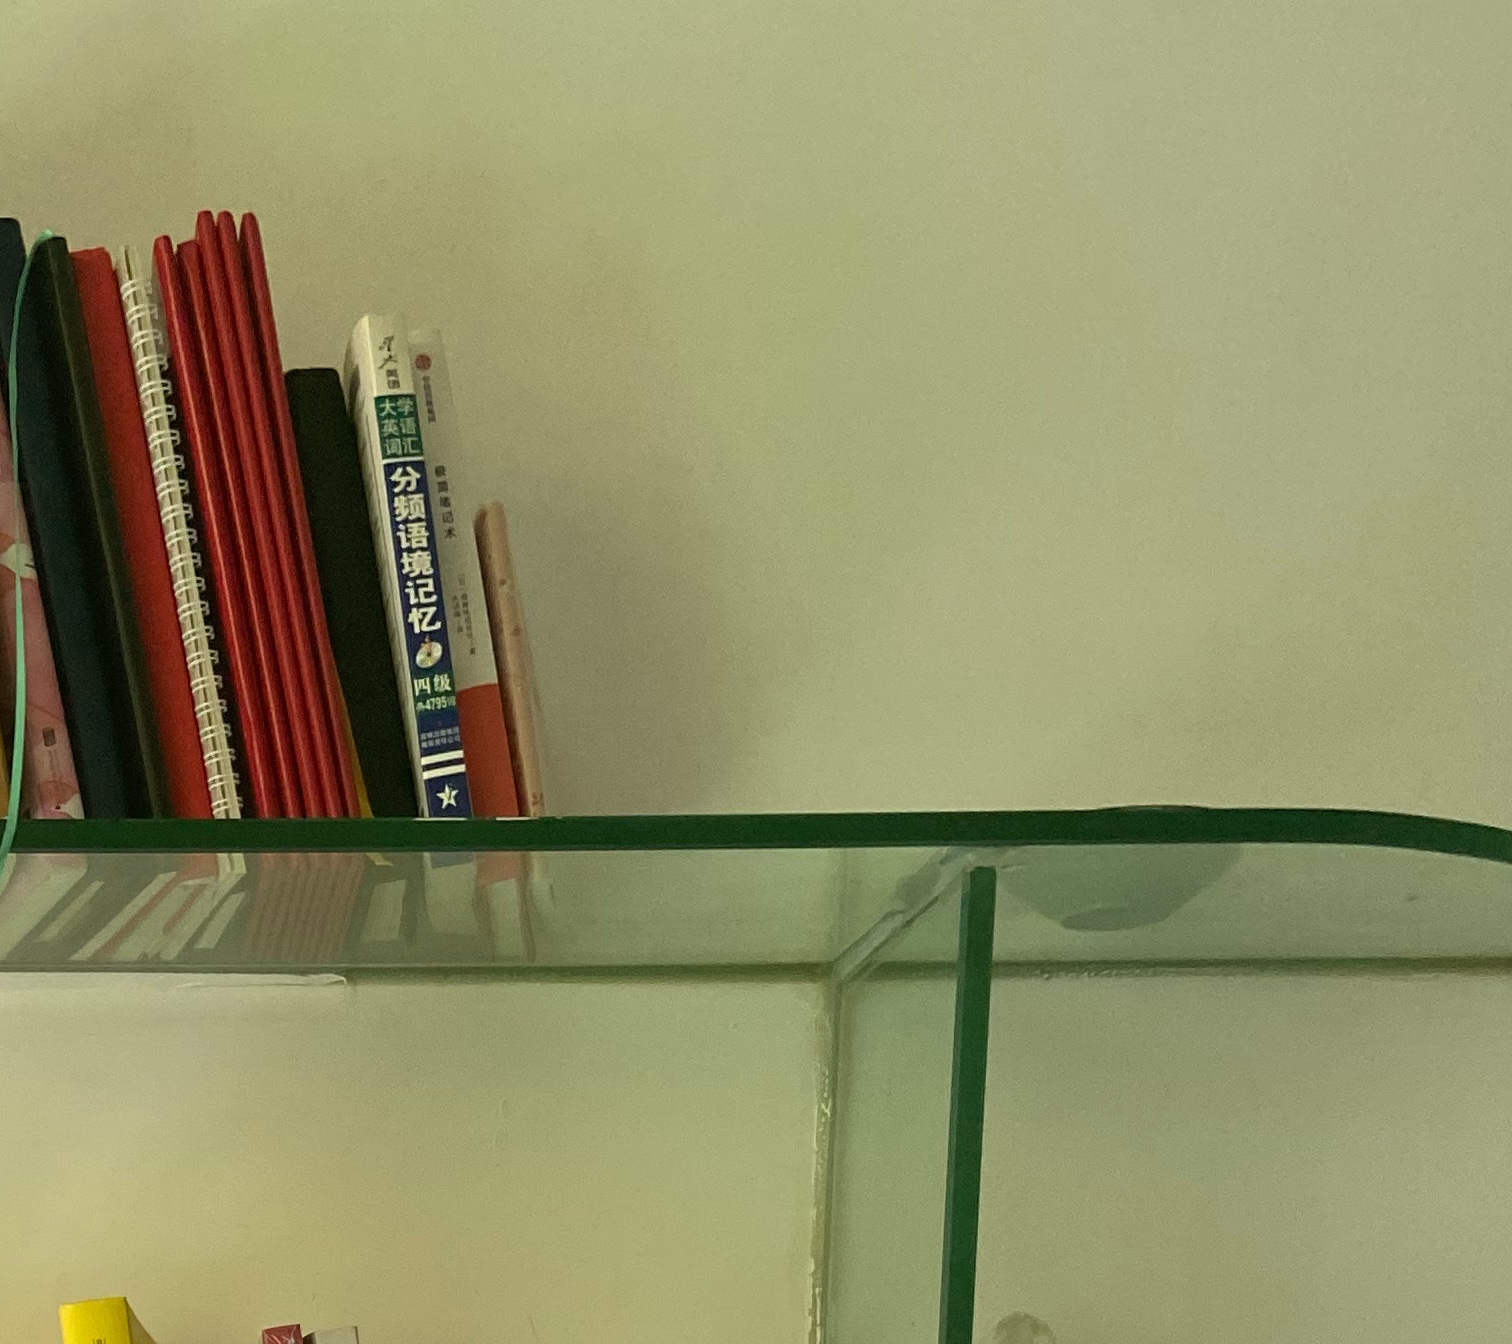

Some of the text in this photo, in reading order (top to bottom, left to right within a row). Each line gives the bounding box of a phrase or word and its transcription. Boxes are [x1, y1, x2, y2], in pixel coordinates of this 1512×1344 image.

[390, 466, 442, 634] 分频语境记忆
